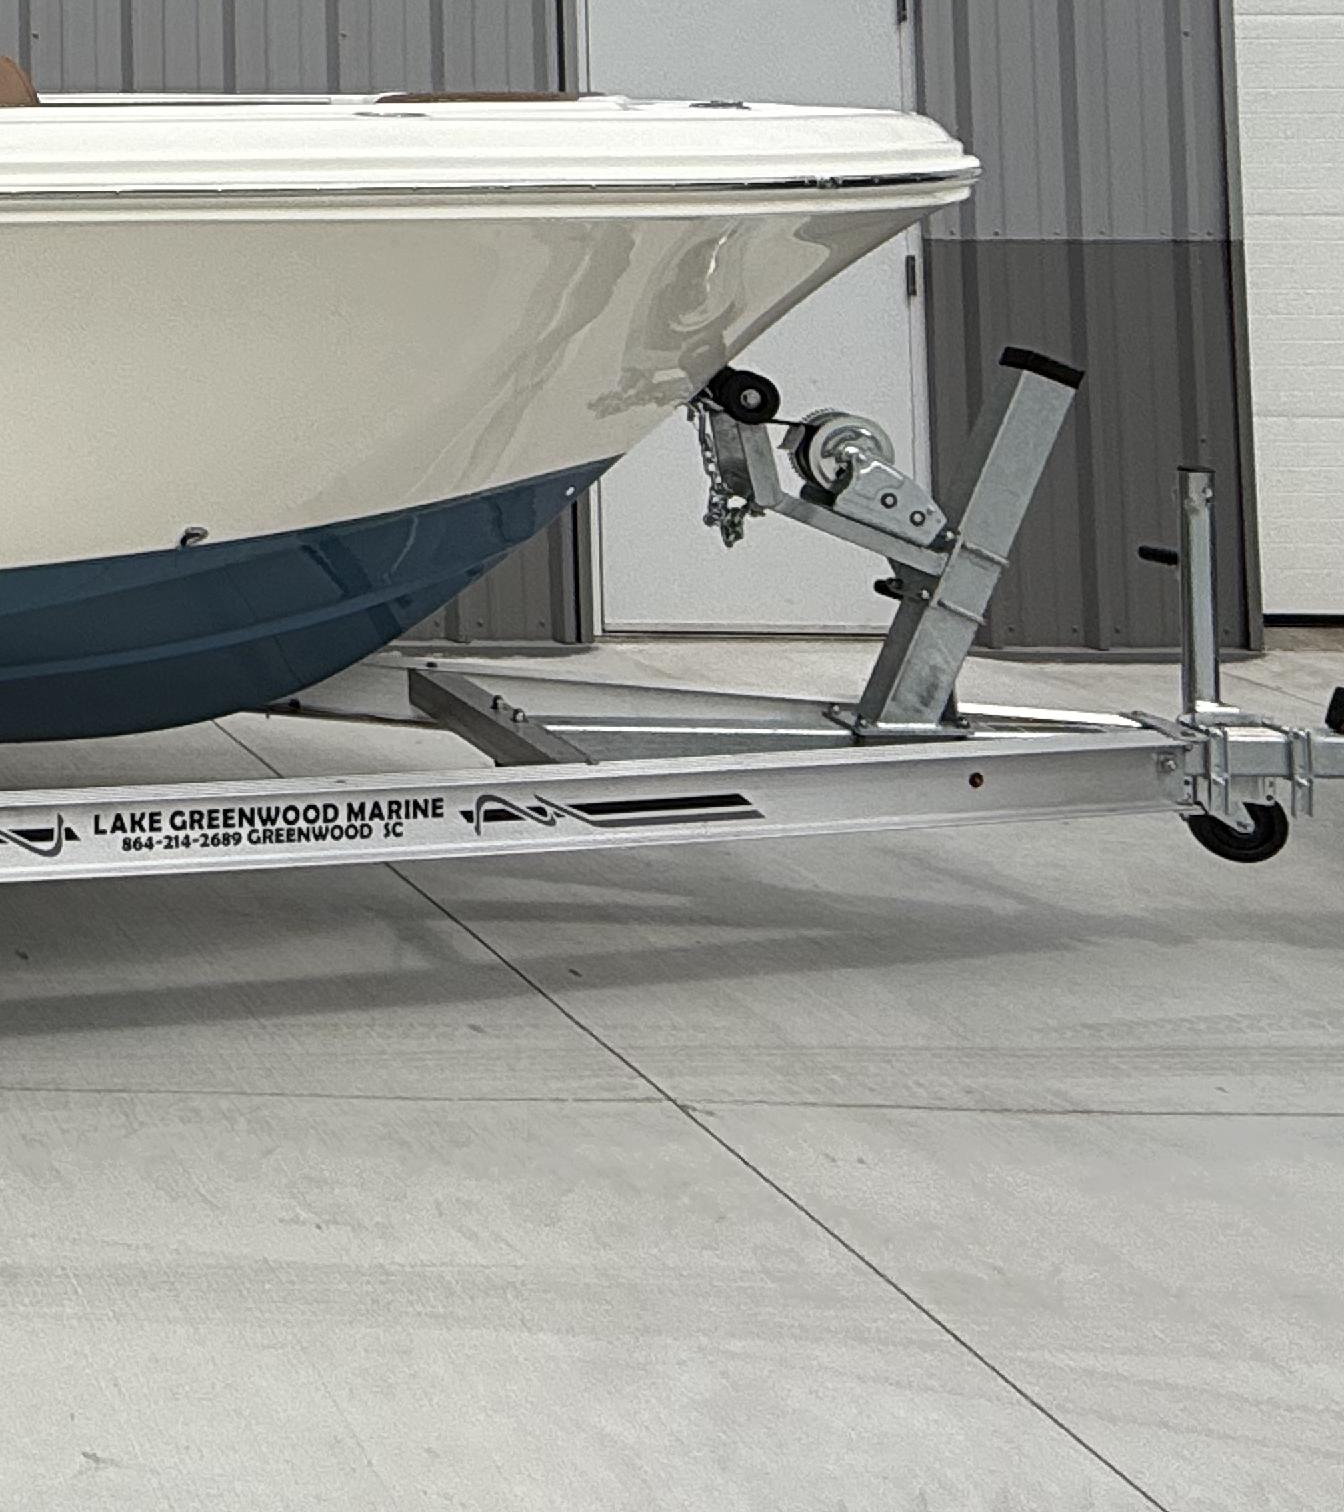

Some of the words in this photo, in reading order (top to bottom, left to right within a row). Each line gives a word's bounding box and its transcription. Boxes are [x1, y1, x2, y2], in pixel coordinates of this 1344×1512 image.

[94, 811, 162, 835] LAKE
[169, 803, 339, 831] GREENWOOD
[347, 797, 444, 822] MARINE
[122, 832, 243, 851] 864-214-2689
[247, 823, 373, 845] GREENWOOD
[383, 822, 404, 839] SC
